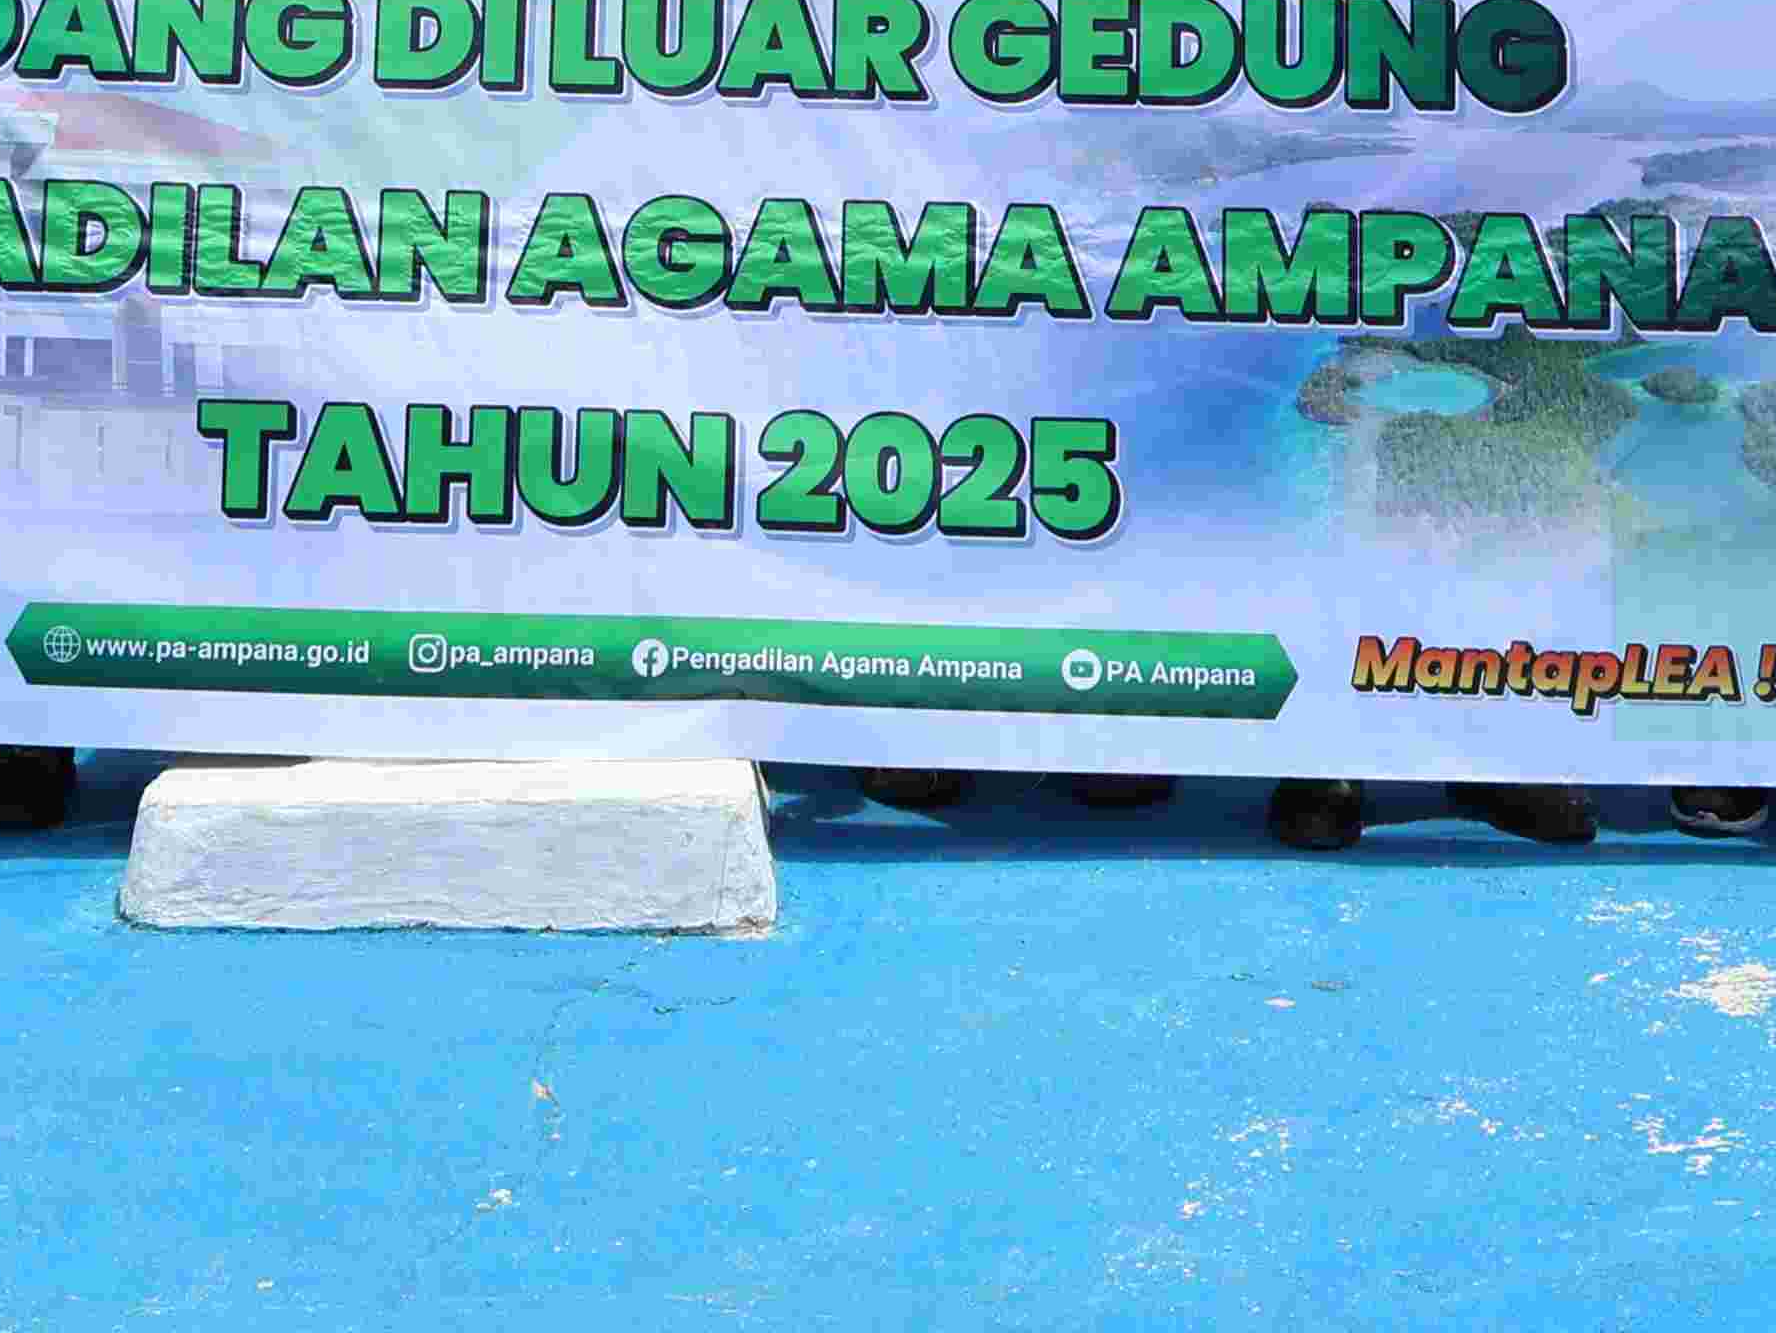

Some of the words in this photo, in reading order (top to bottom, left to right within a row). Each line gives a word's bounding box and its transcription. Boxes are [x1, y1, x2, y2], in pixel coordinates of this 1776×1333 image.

[504, 190, 1088, 326] AGAMA
[197, 397, 740, 535] TAHUN
[754, 407, 1122, 541] 2025
[86, 635, 370, 669] www.pa-ampana.go.id
[450, 643, 595, 672] pa_ampana
[671, 645, 814, 676] Pengadilan
[821, 651, 911, 681] Agama
[918, 652, 1023, 685] Ampana
[1106, 659, 1144, 685] PA
[1150, 661, 1256, 690] Ampana
[1350, 635, 1745, 718] MantapLEA
